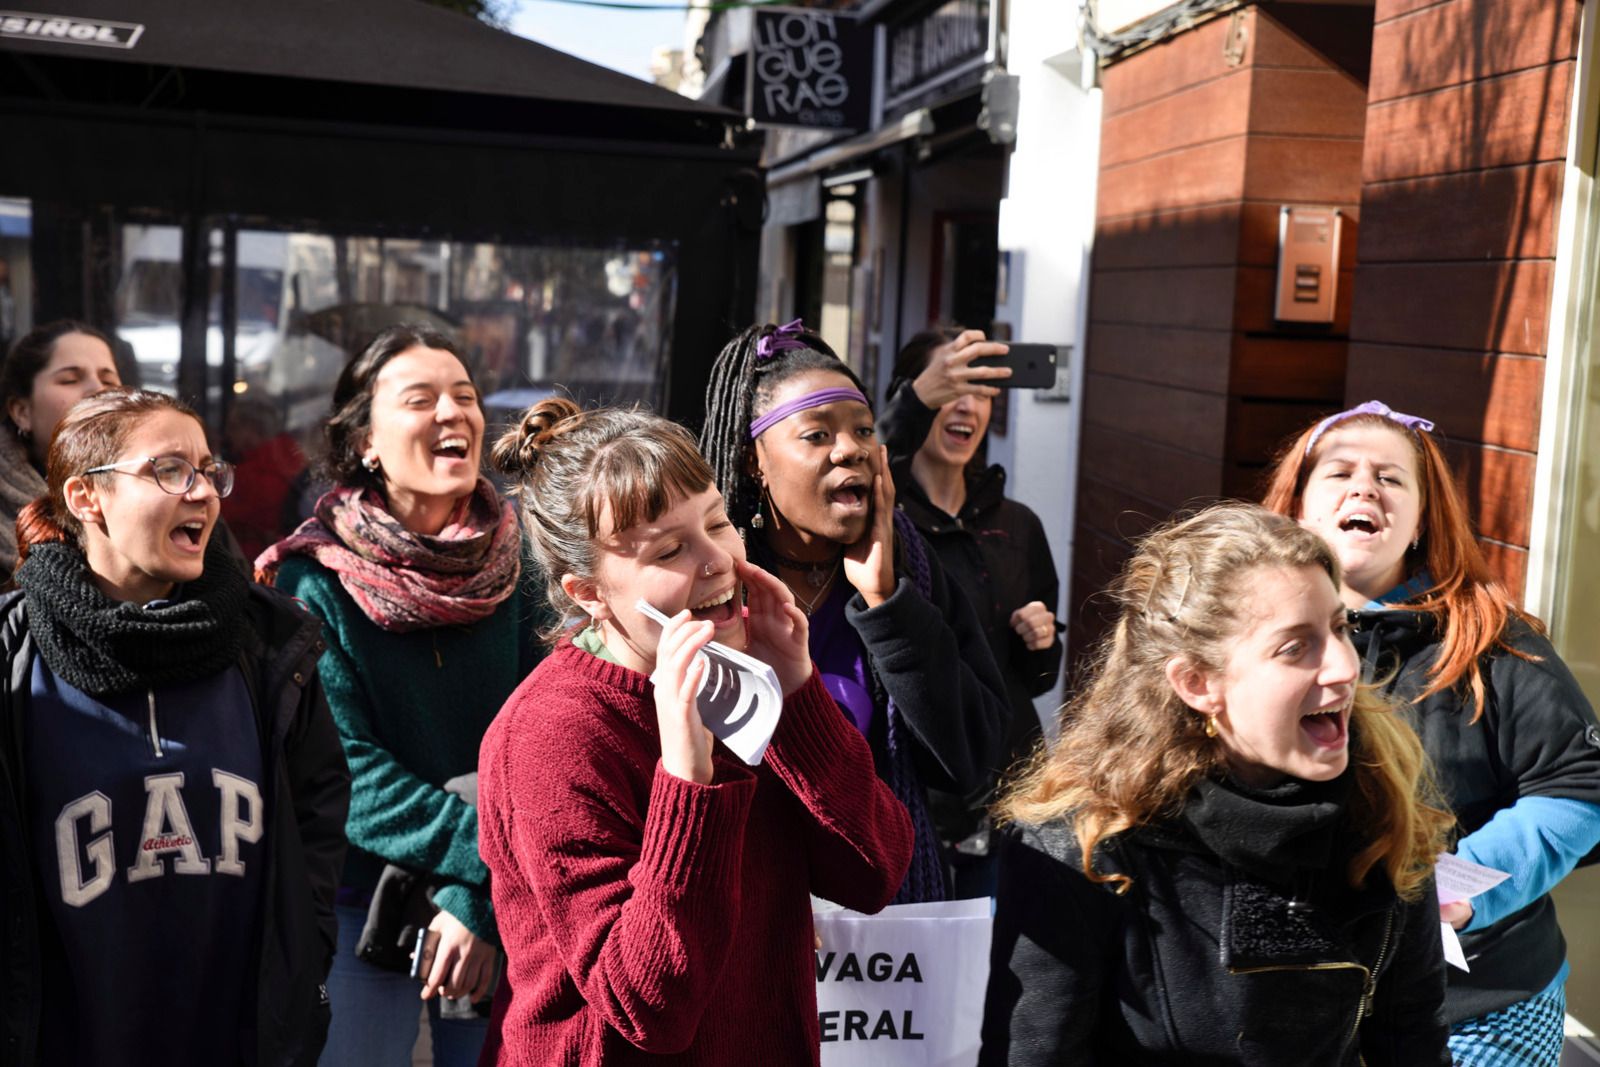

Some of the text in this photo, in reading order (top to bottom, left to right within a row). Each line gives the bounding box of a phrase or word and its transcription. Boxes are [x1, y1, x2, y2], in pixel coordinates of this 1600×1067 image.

[0, 17, 119, 42] SIÑOL
[55, 768, 263, 907] GAP
[815, 952, 923, 983] VAGA
